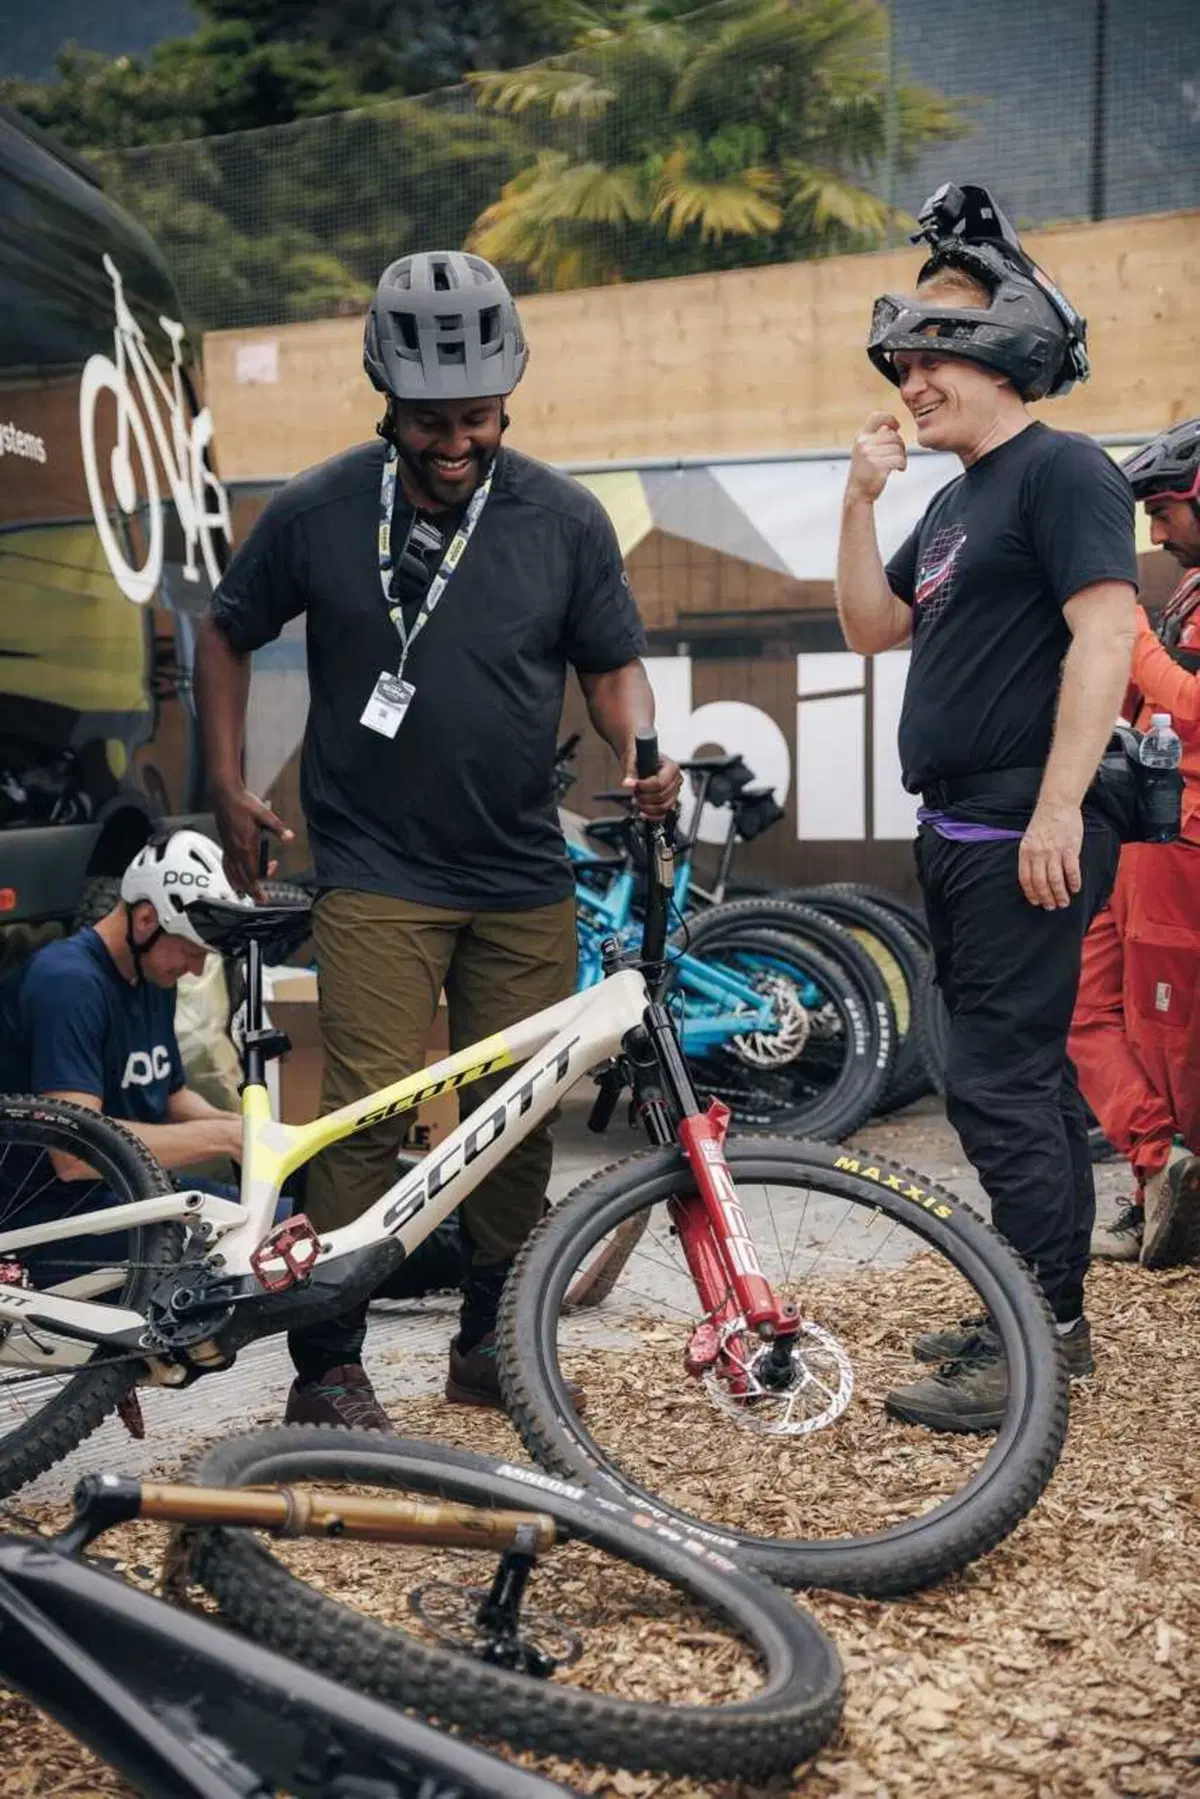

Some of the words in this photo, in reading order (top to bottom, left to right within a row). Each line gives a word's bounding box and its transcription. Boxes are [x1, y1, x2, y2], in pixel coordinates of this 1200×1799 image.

[356, 1055, 504, 1127] SCOTT
[383, 1036, 581, 1235] SCOTT
[833, 1155, 953, 1219] MAXXIS
